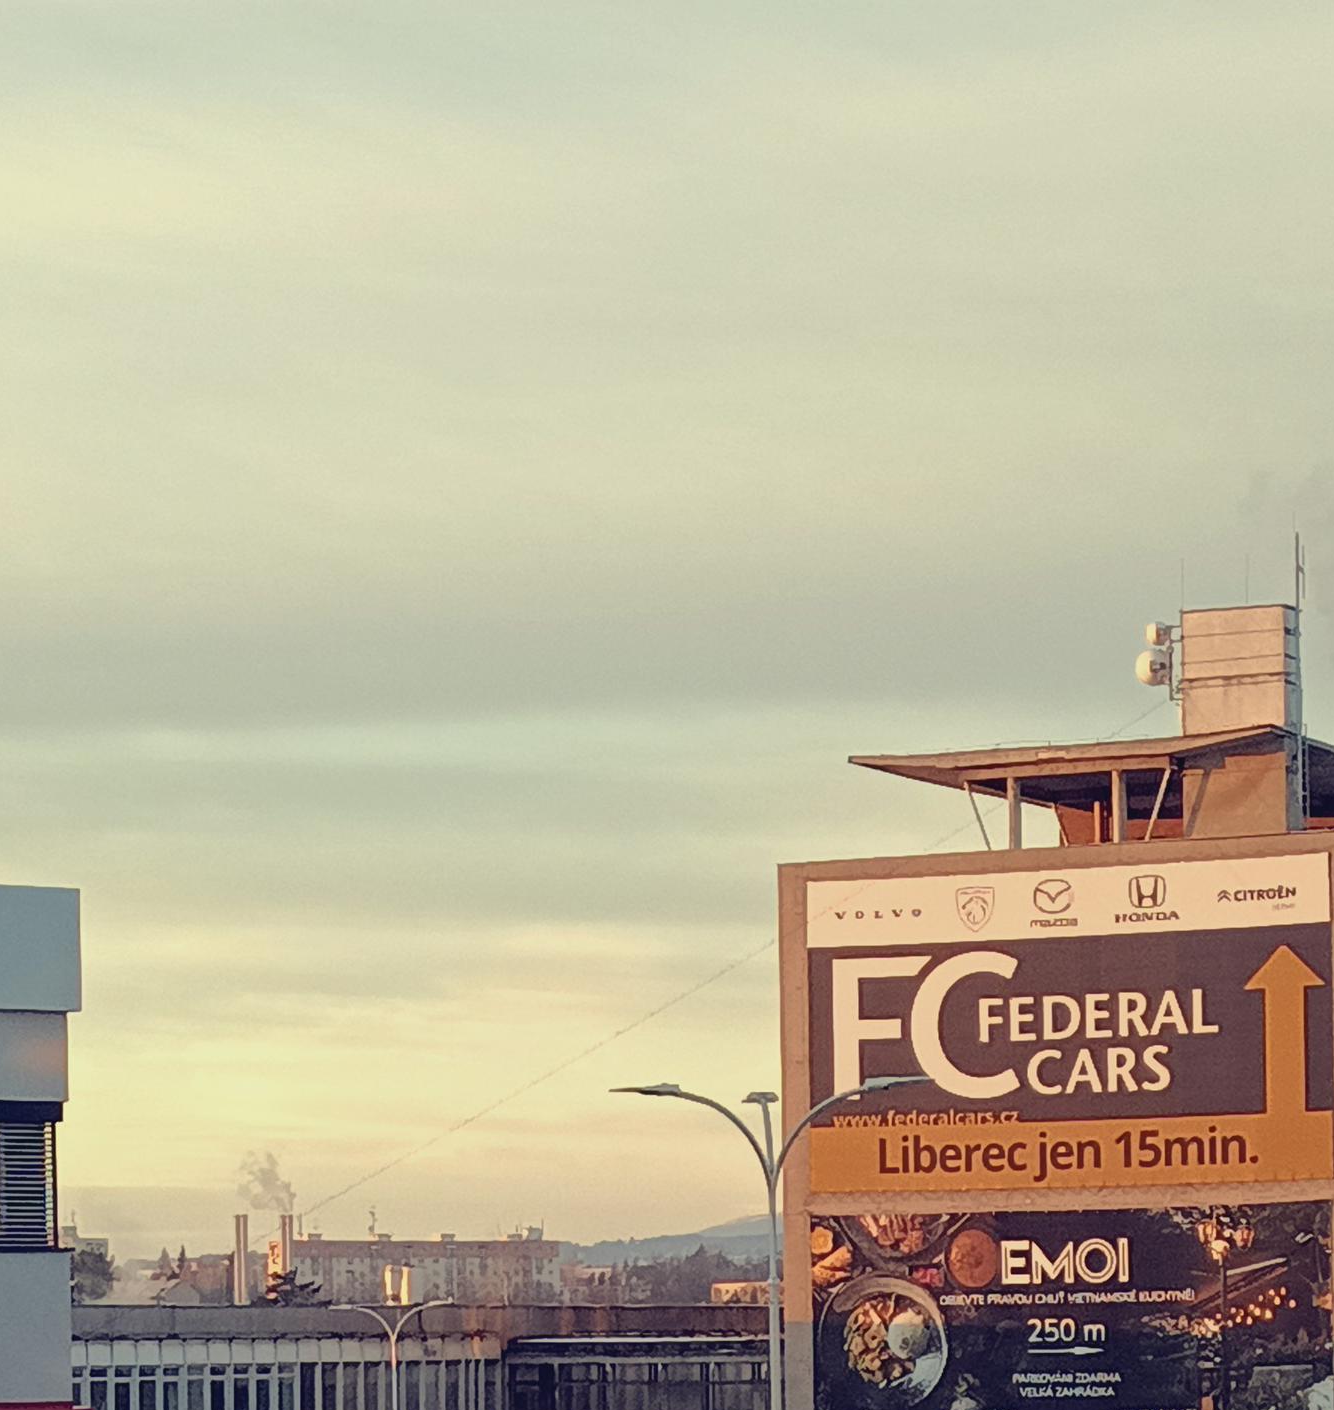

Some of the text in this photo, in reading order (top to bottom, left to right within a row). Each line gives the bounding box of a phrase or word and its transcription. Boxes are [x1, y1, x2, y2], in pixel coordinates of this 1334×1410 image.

[833, 908, 923, 921] VOLVO
[1114, 908, 1180, 924] HONDA
[831, 950, 1020, 1101] FC
[977, 987, 1219, 1042] FEDERAL
[1026, 1044, 1172, 1096] CARS
[832, 1108, 1020, 1128] www.federalcars.cz
[877, 1126, 1259, 1182] Liberec jen 15min.
[1000, 1237, 1130, 1286] EMOI
[1027, 1318, 1106, 1343] 250 m
